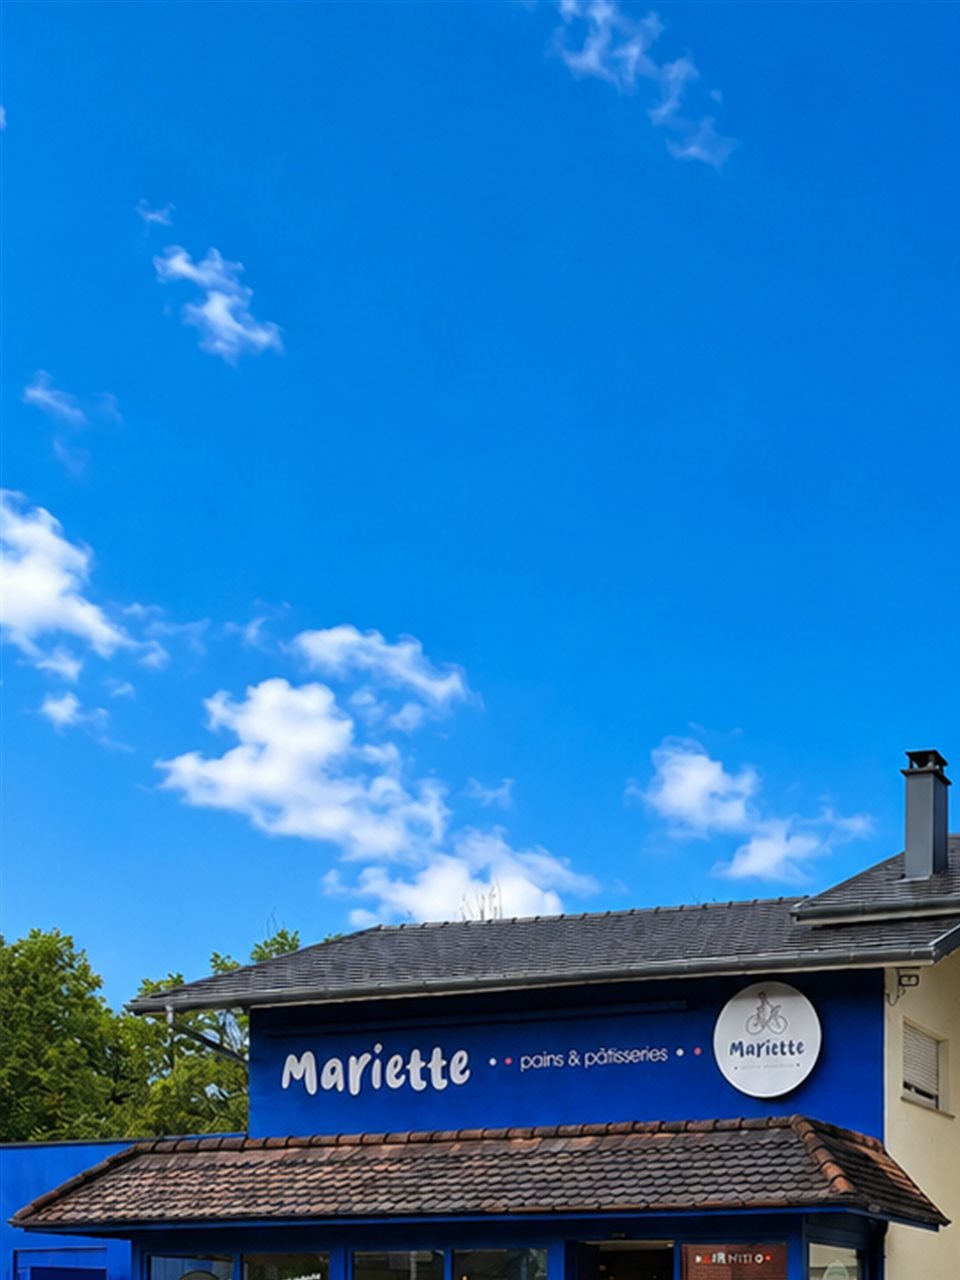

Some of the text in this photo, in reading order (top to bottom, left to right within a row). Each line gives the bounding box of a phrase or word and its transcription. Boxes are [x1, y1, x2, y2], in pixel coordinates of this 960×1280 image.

[520, 1046, 669, 1072] pains & pâtisseries
[729, 1039, 805, 1058] Mariette
[281, 1043, 471, 1096] Mariette
